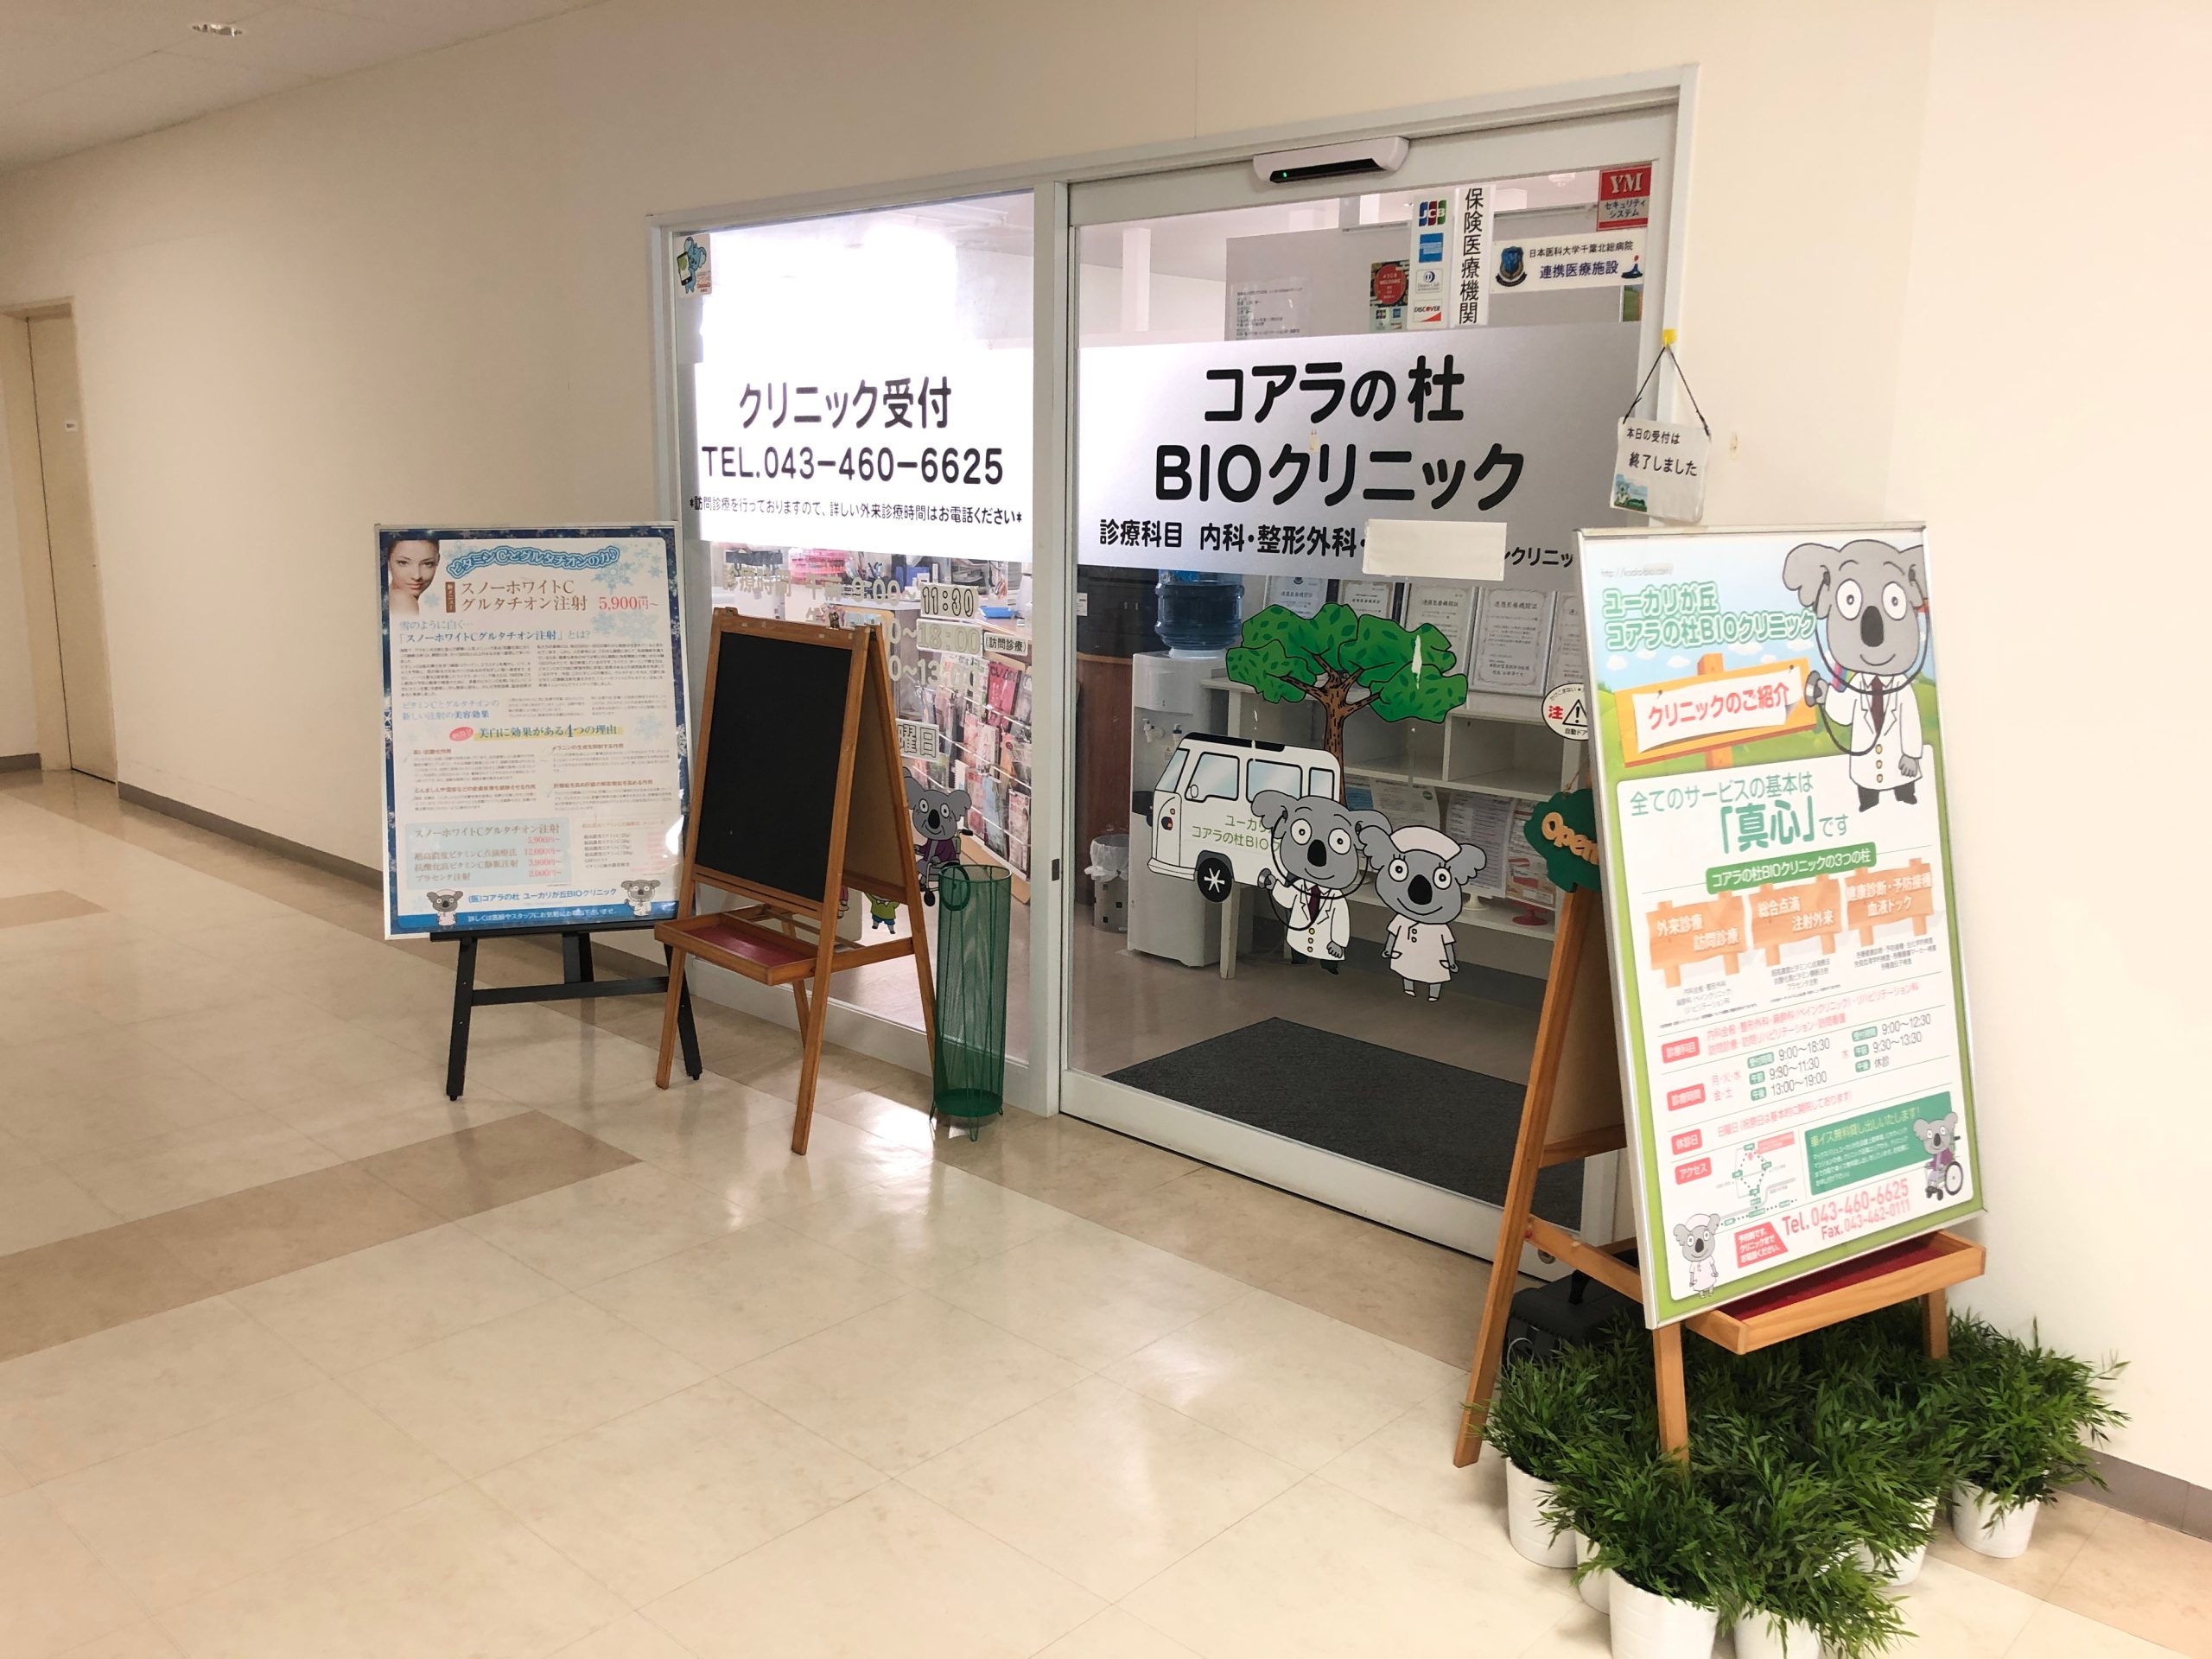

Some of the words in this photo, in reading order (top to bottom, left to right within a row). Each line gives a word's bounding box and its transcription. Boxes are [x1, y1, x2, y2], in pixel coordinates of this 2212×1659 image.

[1611, 173, 1643, 194] YM
[1605, 199, 1645, 211] セキュリティ
[1610, 209, 1639, 219] システム
[1459, 188, 1484, 325] 保険医療機関
[1529, 240, 1634, 258] 日本医科大学千葉北総病院
[1540, 260, 1619, 279] 連携医療施設
[1205, 354, 1465, 423] コアラの杜
[739, 376, 952, 429] クリニック受付
[1627, 427, 1680, 445] 本日の受付は
[1629, 451, 1697, 477] 終了しました
[1156, 442, 1525, 512] BIOクリニック
[1099, 518, 1183, 548] 診療科目
[461, 580, 575, 596] スノーホワイトC
[1603, 582, 1719, 618] ユーカリが丘
[462, 595, 588, 612] グルタチオン注射
[1605, 609, 1816, 651] コアラの杜BIOクリニック
[1548, 705, 1563, 720] 注
[1648, 682, 1790, 731] クリニックのご紹介
[1630, 772, 1814, 817] 全てのサービスの基本は
[1758, 896, 1801, 918] 総合点滴
[1656, 912, 1704, 938] 外来診療
[1792, 909, 1834, 932] 注射外来
[1694, 927, 1739, 952] 訪問診療
[1679, 1163, 1707, 1179] アクセス
[1782, 1212, 1809, 1236] Tel.
[1812, 1178, 1909, 1227] 043-460-6625
[1821, 1225, 1843, 1240] Fax.
